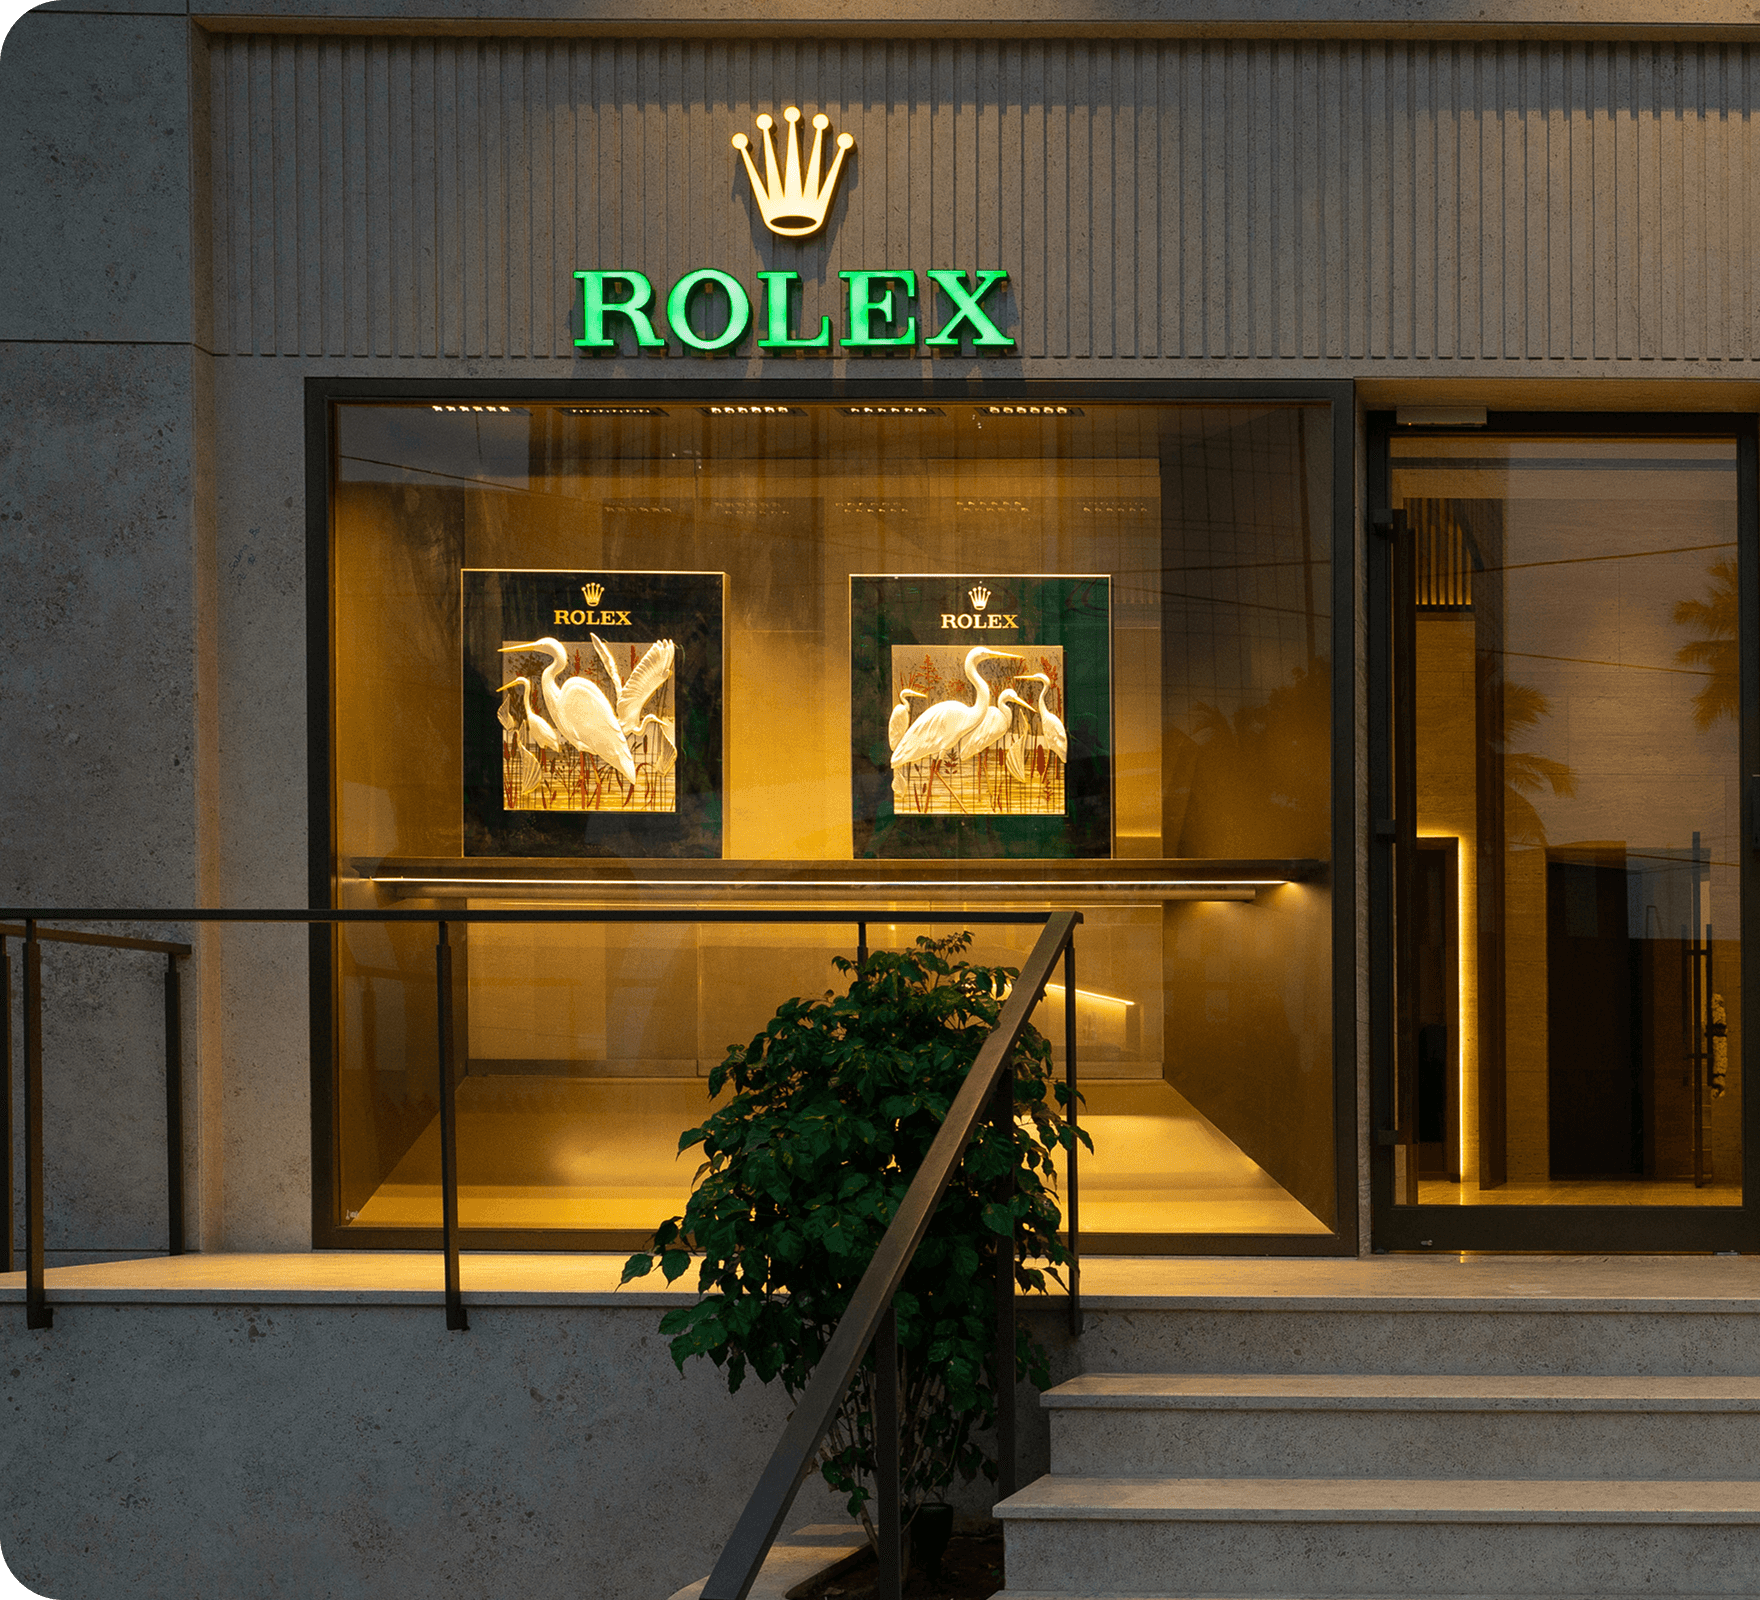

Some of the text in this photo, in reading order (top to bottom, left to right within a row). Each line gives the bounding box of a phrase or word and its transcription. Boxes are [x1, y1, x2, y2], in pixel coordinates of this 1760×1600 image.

[572, 268, 1015, 350] ROLEX
[553, 609, 633, 626] ROLEX
[940, 613, 1020, 630] ROLEX
